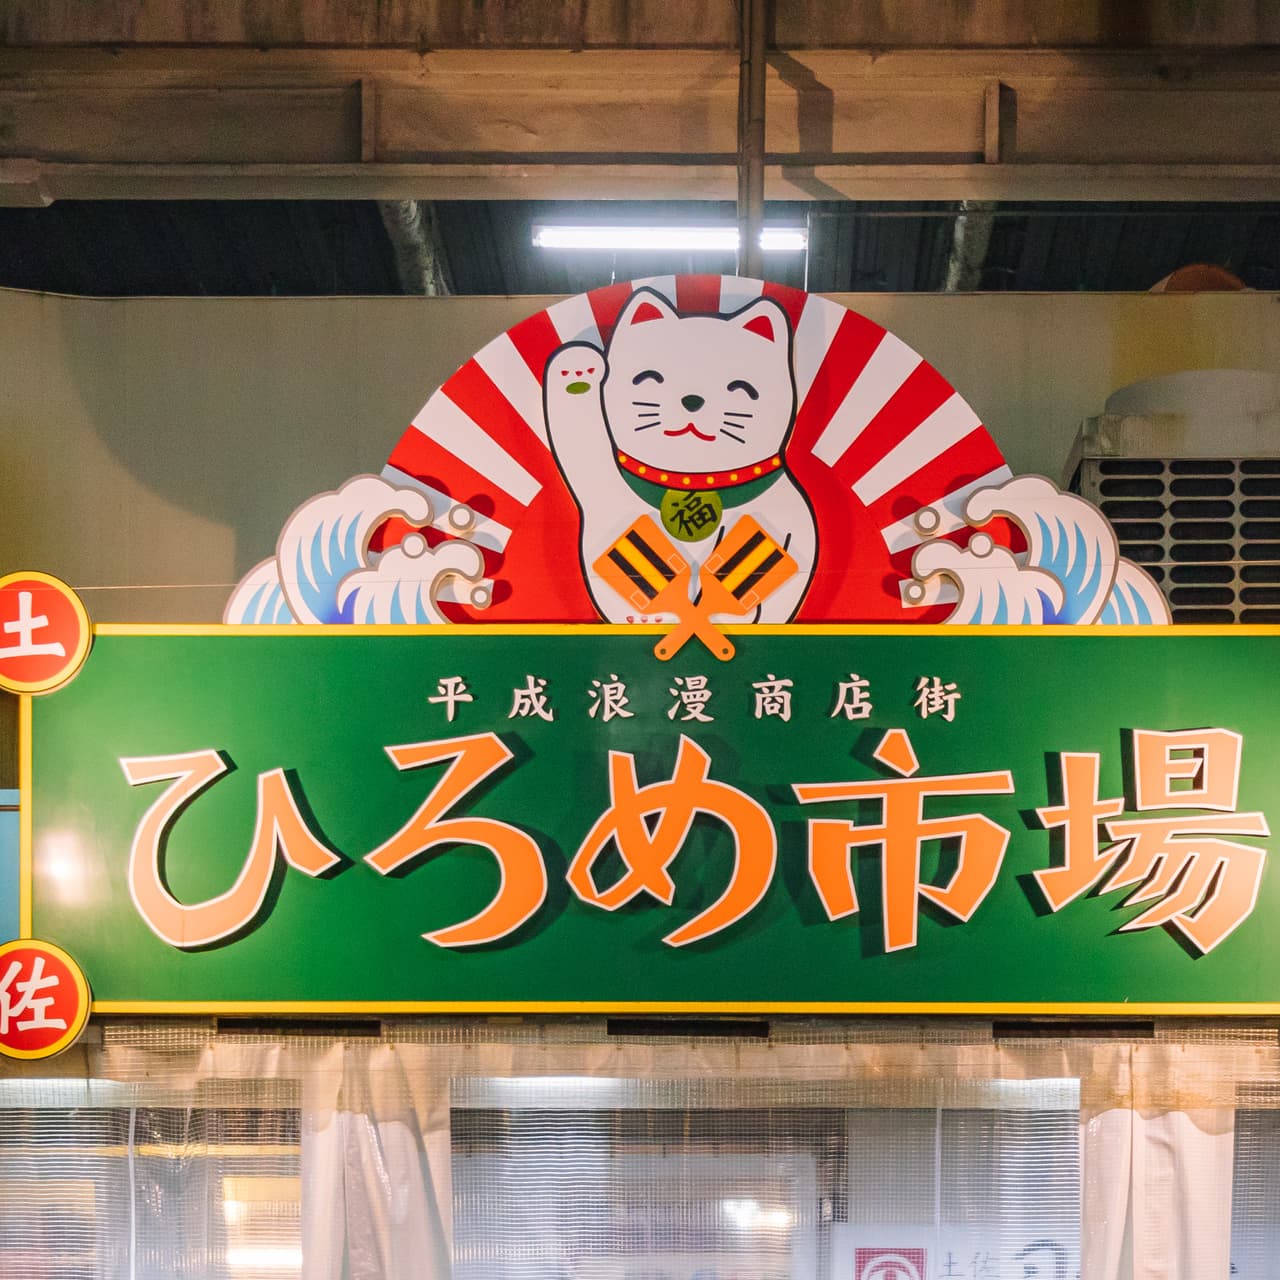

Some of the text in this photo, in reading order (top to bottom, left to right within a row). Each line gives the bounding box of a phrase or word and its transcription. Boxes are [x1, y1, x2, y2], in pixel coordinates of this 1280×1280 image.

[670, 490, 718, 538] 福
[426, 672, 962, 725] 平成浪漫商店街
[118, 726, 1272, 956] ひろめ市場
